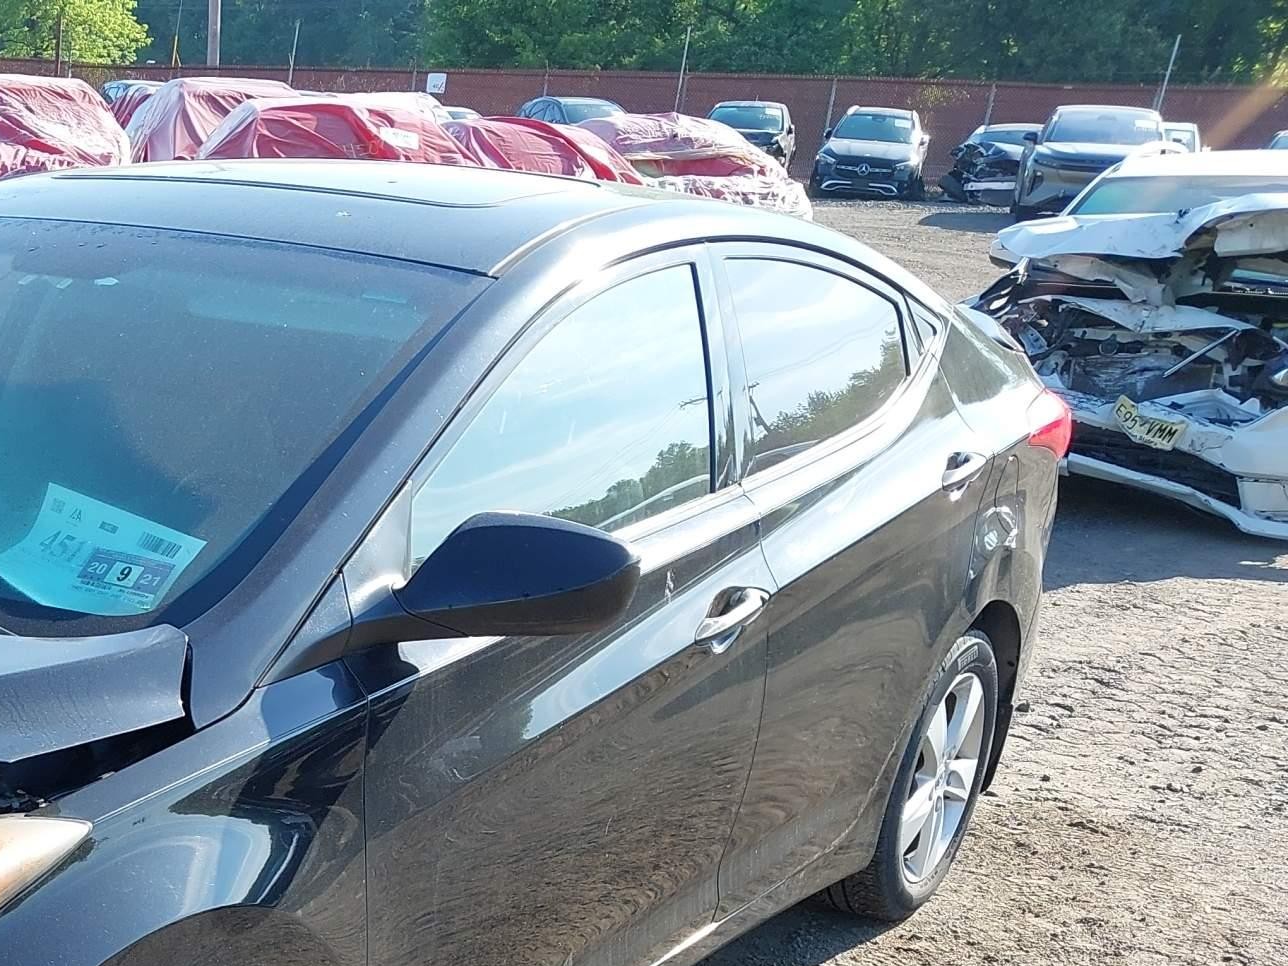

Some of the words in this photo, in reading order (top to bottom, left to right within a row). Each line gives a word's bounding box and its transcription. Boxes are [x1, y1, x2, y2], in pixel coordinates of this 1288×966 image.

[1115, 403, 1138, 430] E95
[1145, 421, 1178, 444] VMM
[87, 561, 108, 575] 20
[116, 565, 133, 582] 9
[139, 573, 161, 587] 21
